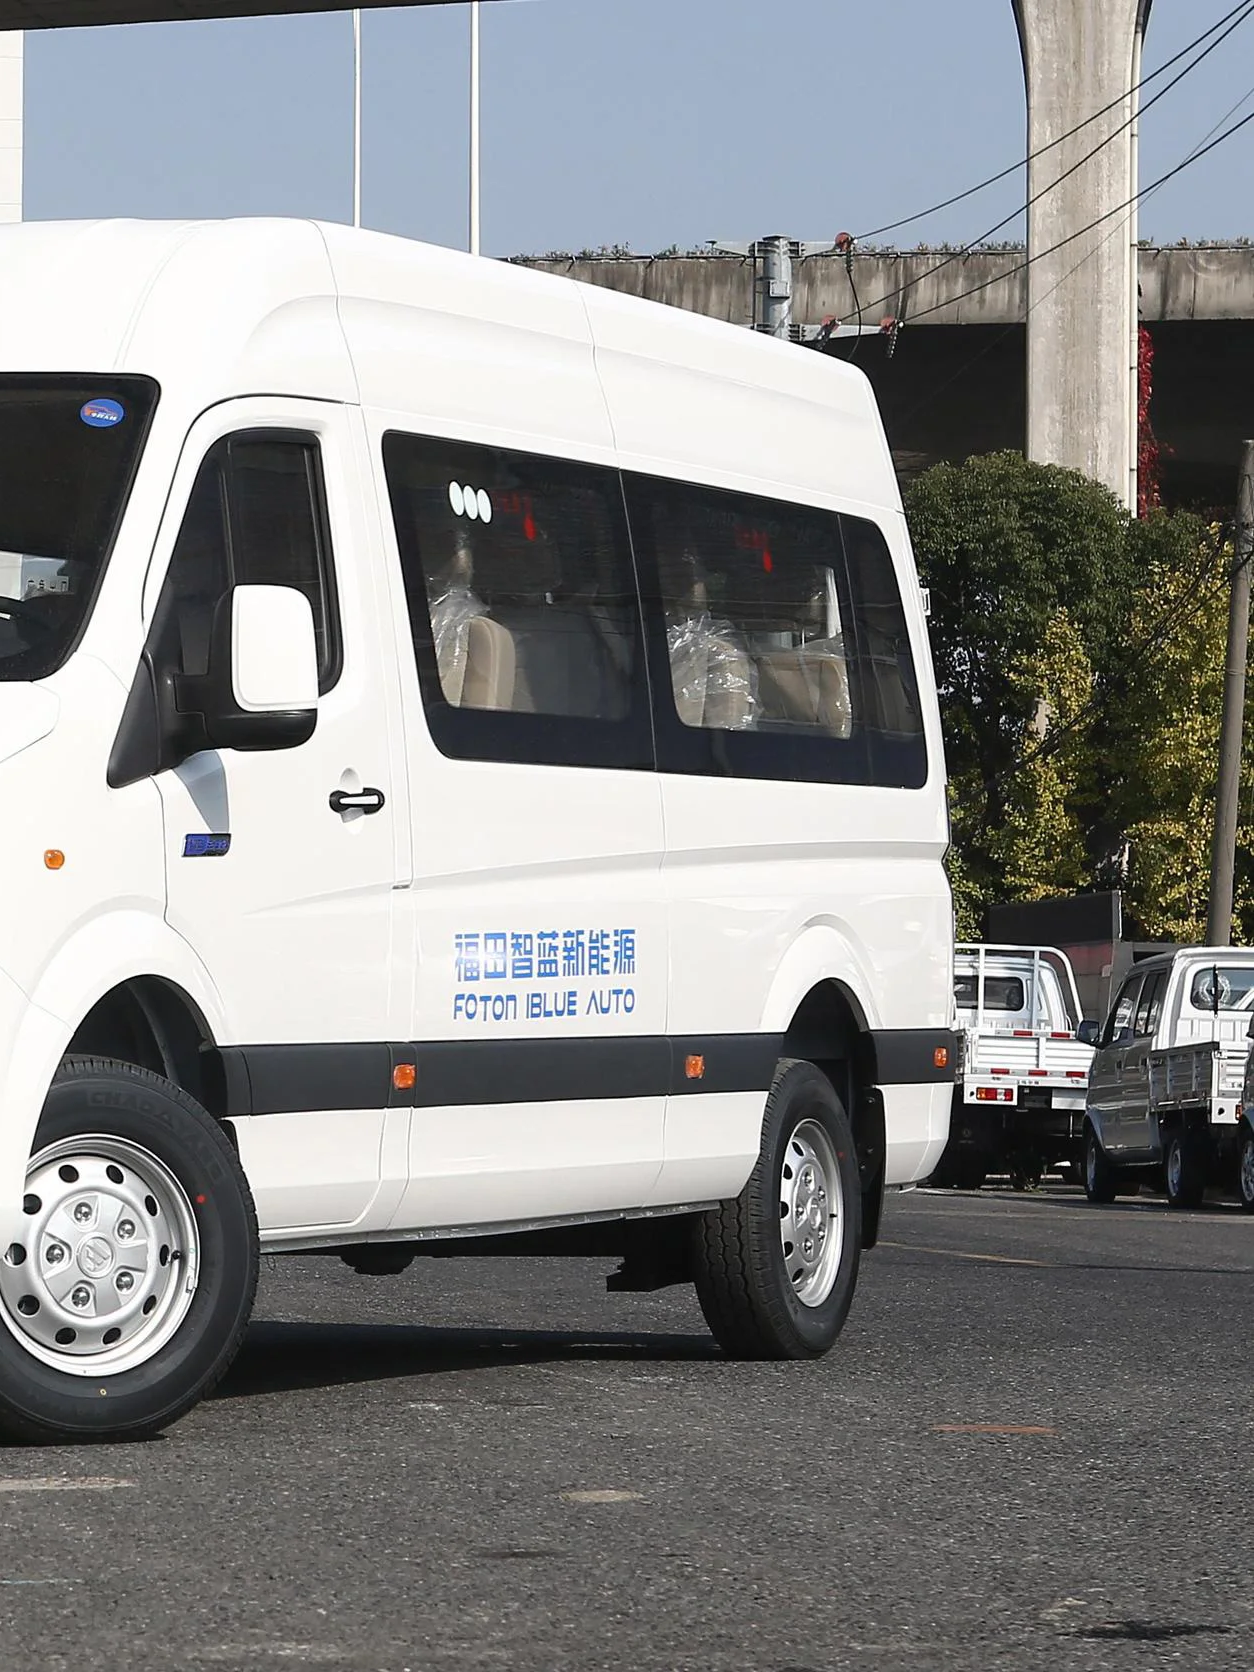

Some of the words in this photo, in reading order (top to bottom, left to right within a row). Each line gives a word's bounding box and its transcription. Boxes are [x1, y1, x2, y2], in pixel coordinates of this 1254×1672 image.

[454, 929, 636, 982] 福田智蓝新能源
[453, 993, 517, 1022] FOTON
[586, 988, 636, 1015] AUTO
